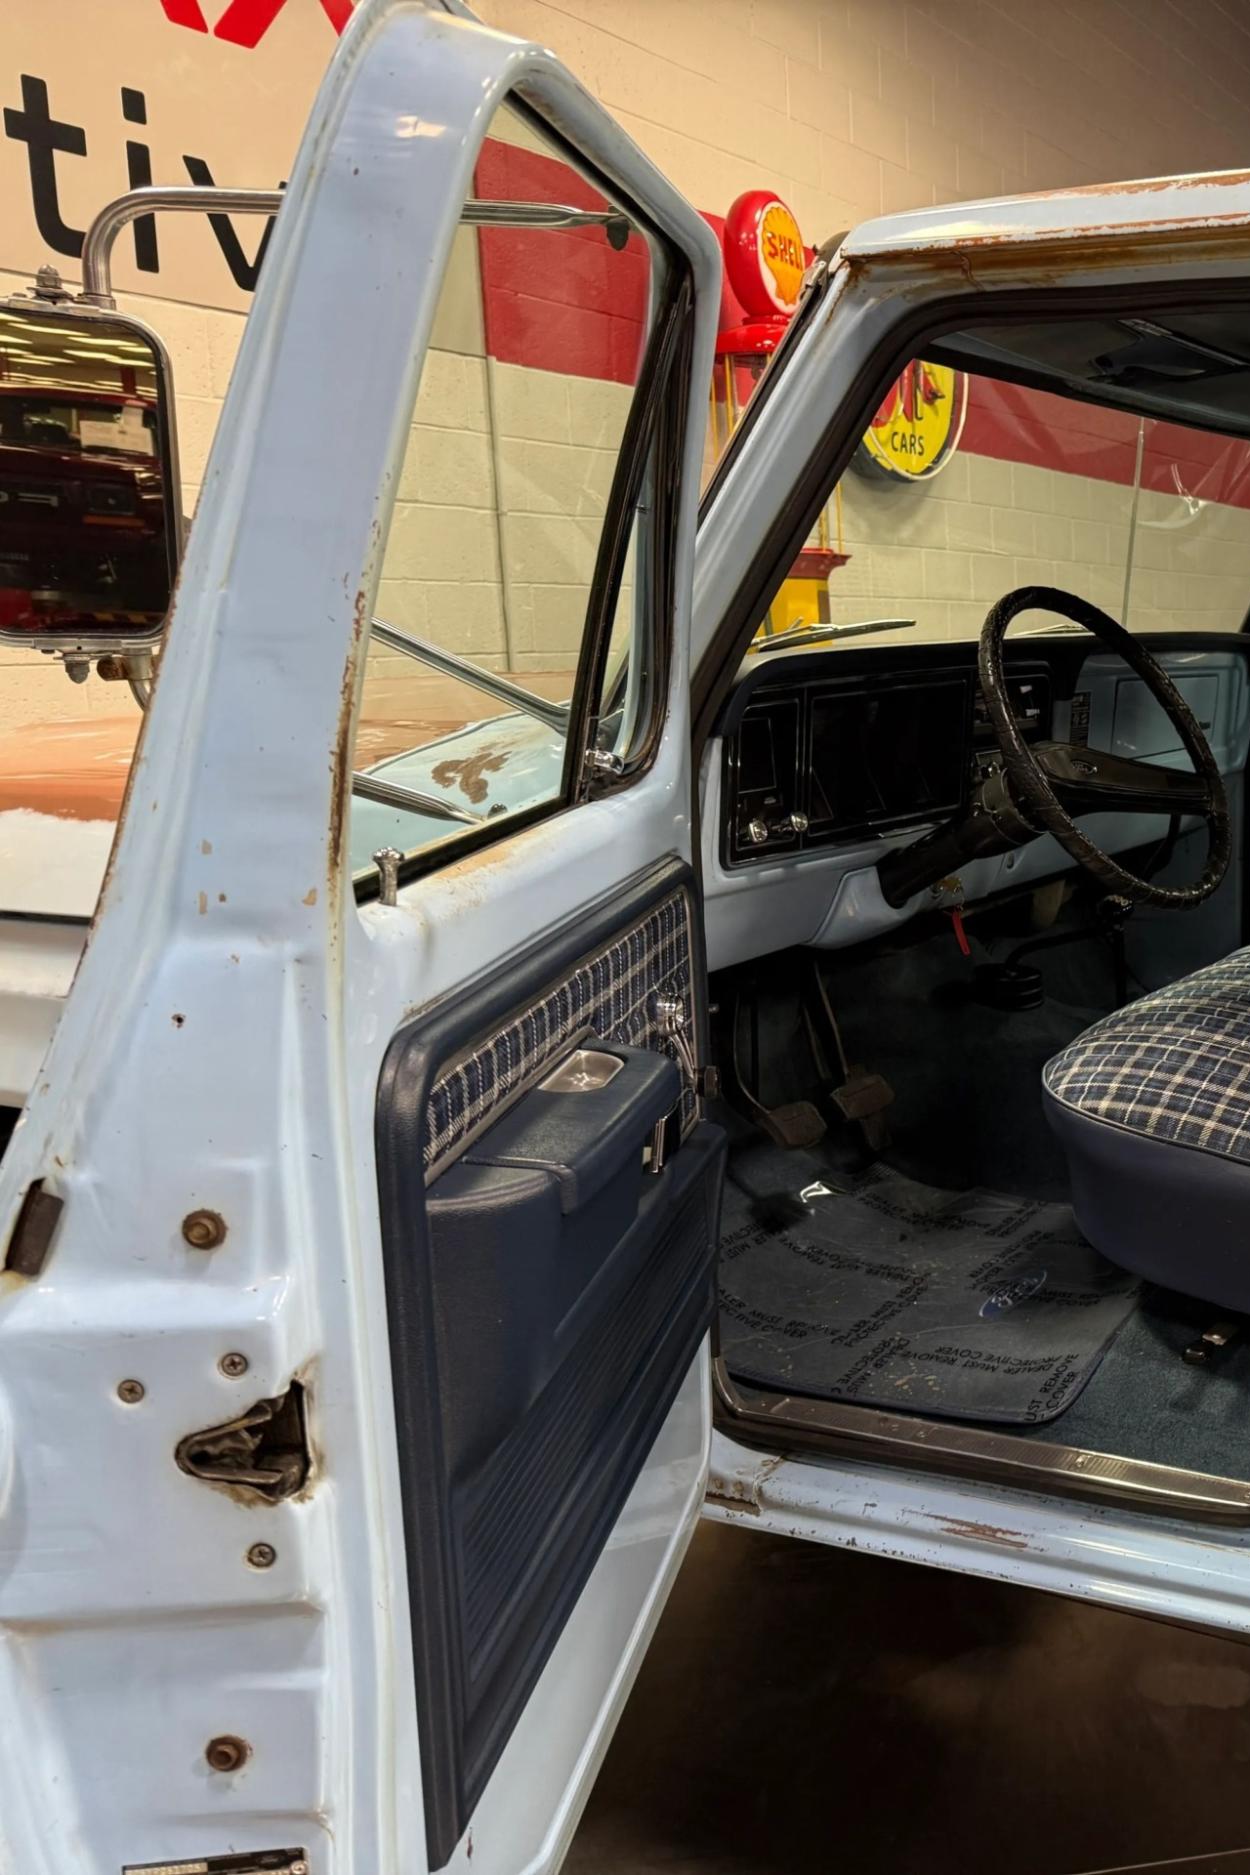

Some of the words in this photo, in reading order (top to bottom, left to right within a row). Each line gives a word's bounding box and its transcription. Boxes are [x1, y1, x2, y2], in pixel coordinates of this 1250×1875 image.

[891, 431, 925, 457] CARS
[718, 1287, 747, 1310] ALER
[934, 1346, 982, 1360] COVER
[961, 1359, 998, 1373] MUST
[1003, 1363, 1052, 1375] DEALER
[1023, 1399, 1042, 1421] UST
[1039, 1354, 1079, 1393] REMOVE
[1046, 1371, 1076, 1409] COVER
